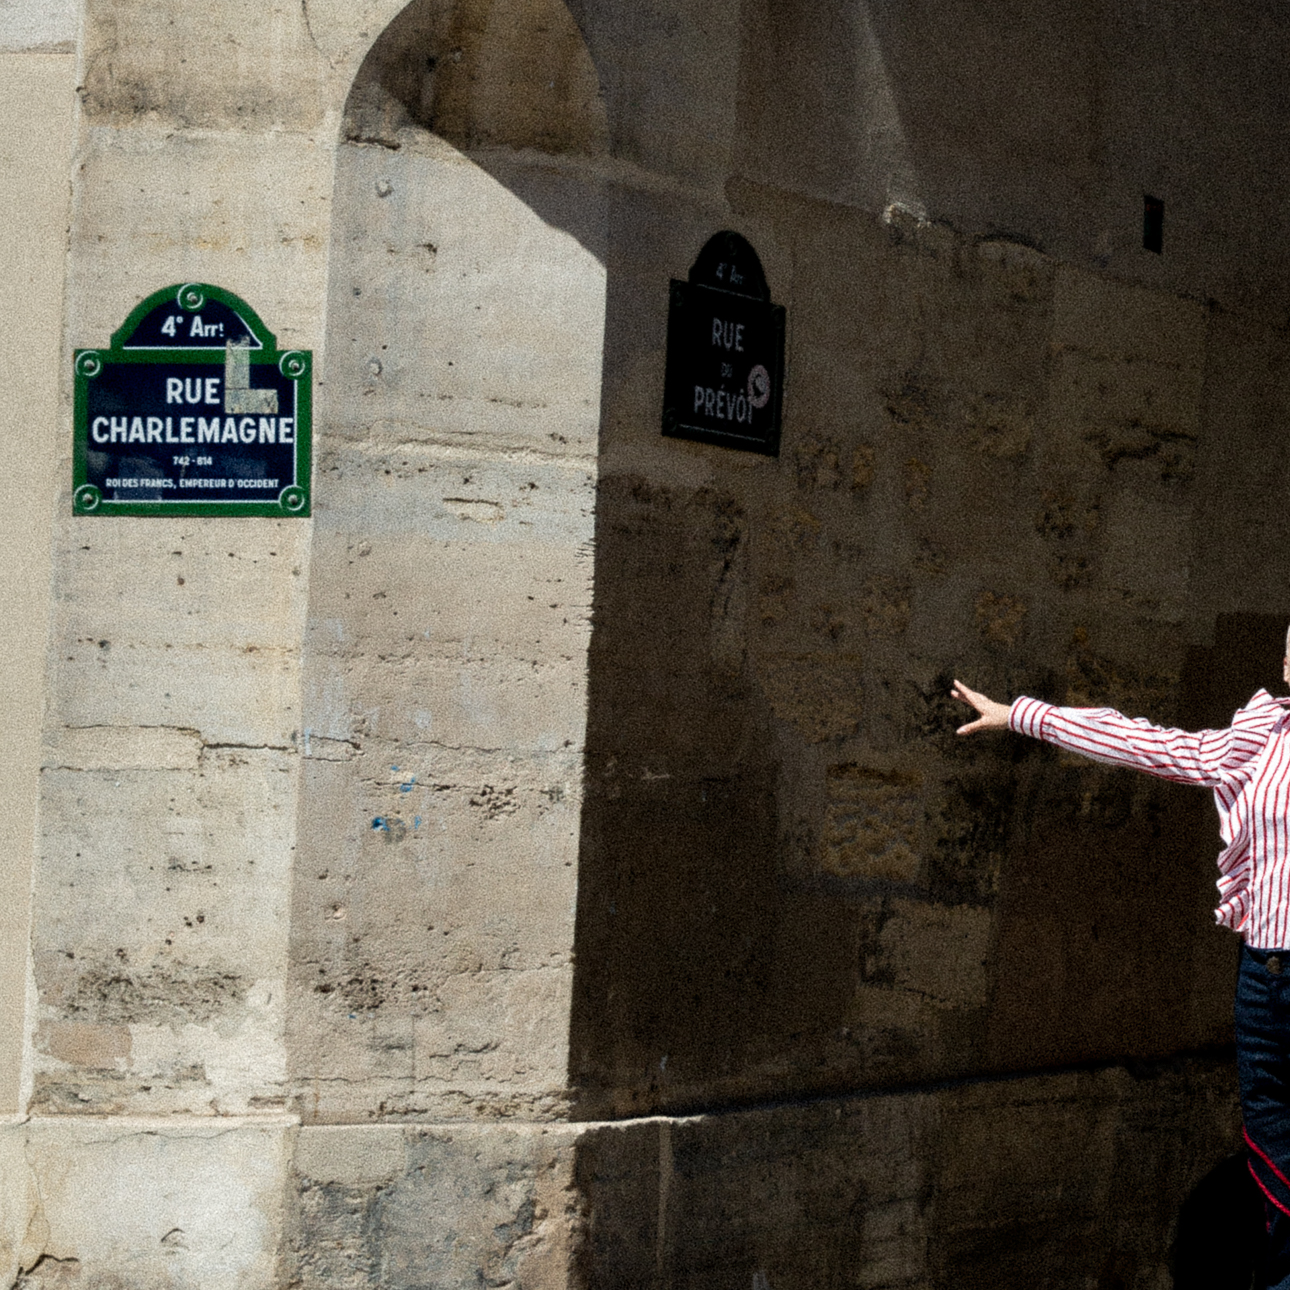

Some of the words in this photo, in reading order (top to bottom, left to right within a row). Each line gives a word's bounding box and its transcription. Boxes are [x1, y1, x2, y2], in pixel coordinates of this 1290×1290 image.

[711, 316, 746, 354] RUE
[720, 361, 734, 379] DU
[166, 377, 221, 405] RUE
[92, 416, 295, 444] CHARLEMAGNE
[105, 478, 121, 488] ROI
[122, 478, 139, 488] DES
[140, 478, 177, 490] FRANCS,
[179, 478, 226, 488] EMPEREUR
